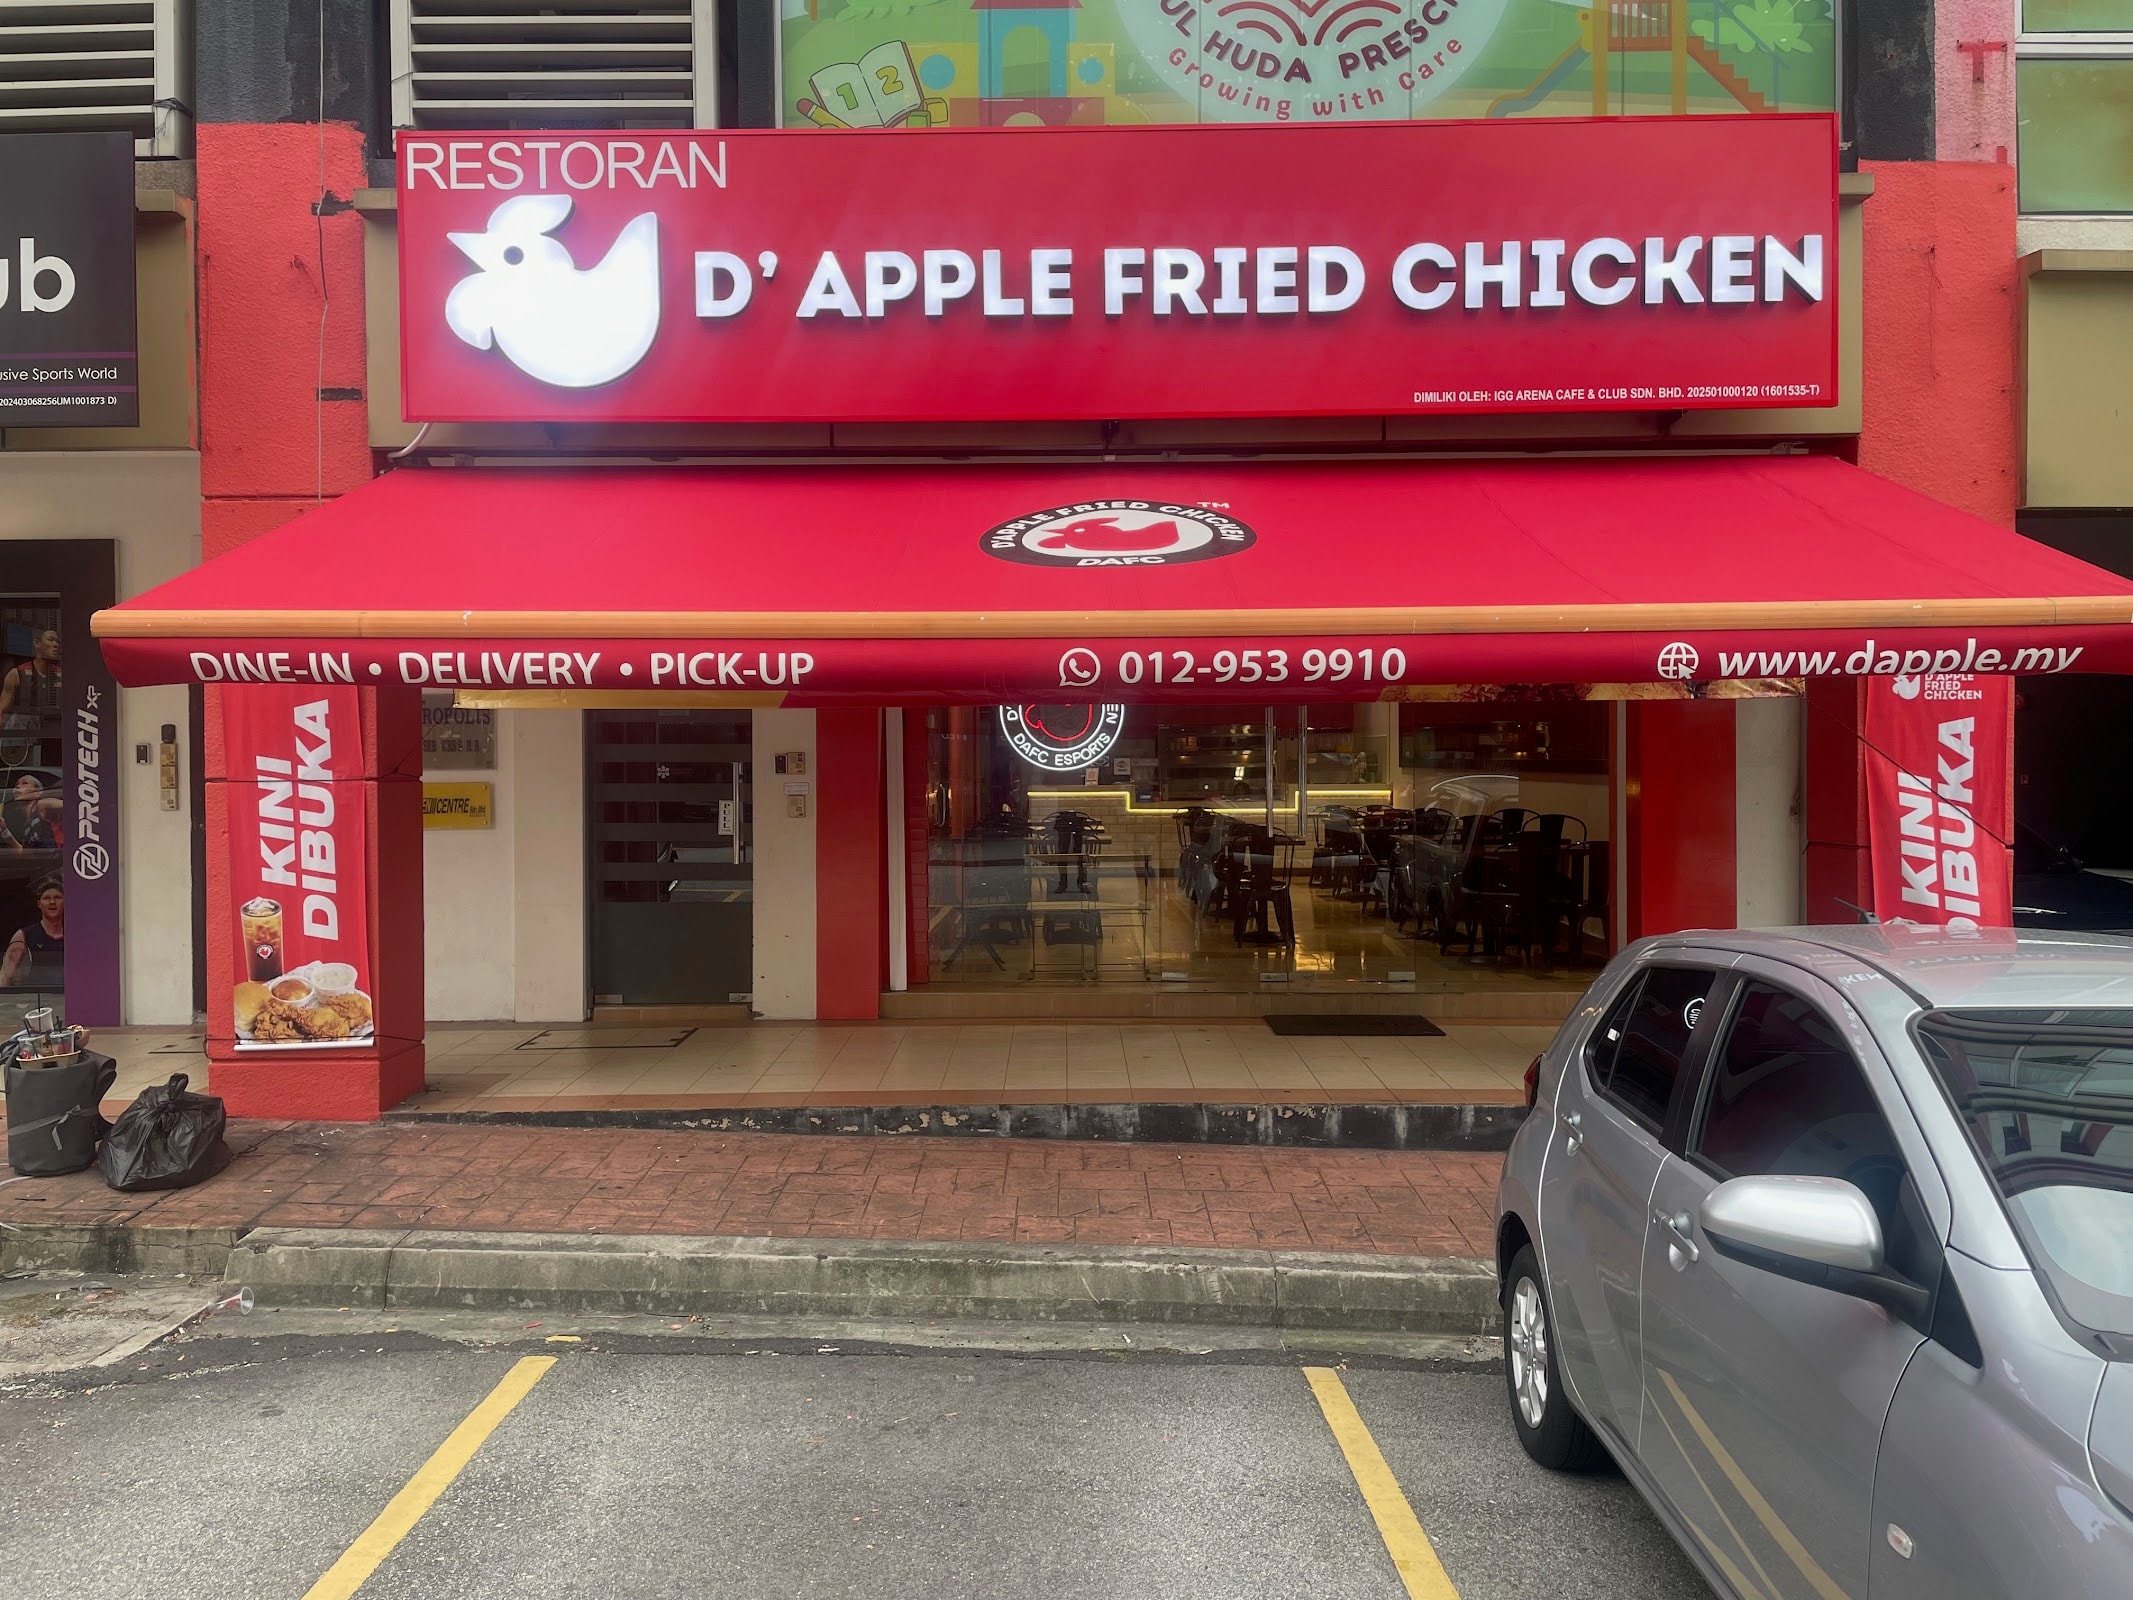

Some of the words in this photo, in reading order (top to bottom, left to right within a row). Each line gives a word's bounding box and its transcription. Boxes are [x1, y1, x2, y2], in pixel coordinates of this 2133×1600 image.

[1203, 30, 1312, 84] HUDA
[1338, 0, 1458, 79] PRESC
[1169, 48, 1292, 120] Growing
[1312, 88, 1385, 116] with
[1398, 39, 1462, 90] Care
[406, 141, 727, 190] RESTORAN
[0, 238, 76, 313] b
[796, 247, 1074, 318] APPLE
[1104, 246, 1366, 316] FRIED
[1392, 234, 1824, 311] CHICKEN
[0, 368, 28, 380] sive
[32, 368, 74, 383] Sports
[77, 367, 118, 380] World
[1414, 392, 1456, 402] DIMILIKI
[1459, 391, 1492, 402] OLEH:
[1494, 391, 1513, 401] IGG
[1516, 390, 1553, 401] ARENA
[1556, 389, 1585, 400] CAFE
[1588, 389, 1595, 399] &
[1598, 389, 1627, 399] CLUB
[1630, 388, 1656, 399] SDN.
[1658, 388, 1685, 398] BHD.
[1687, 387, 1758, 398] 202501000120
[1761, 385, 1820, 397] (1601535-T)
[107, 396, 117, 406] D)
[1056, 501, 1149, 516] FRIED
[1159, 505, 1245, 541] CHICKEN
[1197, 501, 1230, 509] TM
[1077, 556, 1166, 566] DAFC
[189, 652, 355, 683] DINE-IN
[399, 652, 601, 685] DELIVERY
[651, 652, 814, 685] PICK-UP
[1118, 649, 1289, 684] 012-953
[1302, 647, 1407, 682] 9910
[1718, 638, 2084, 675] www.dapple.my
[1924, 681, 1961, 690] FRIED
[1924, 690, 1982, 700] CHICKEN
[1013, 733, 1050, 763] DAFC
[1054, 733, 1111, 766] ESPORTS
[77, 708, 100, 842] PROTECH
[256, 755, 297, 887] KINI
[294, 699, 339, 941] DIBUKA
[723, 803, 732, 829] PULL
[1897, 771, 1940, 909] KINI
